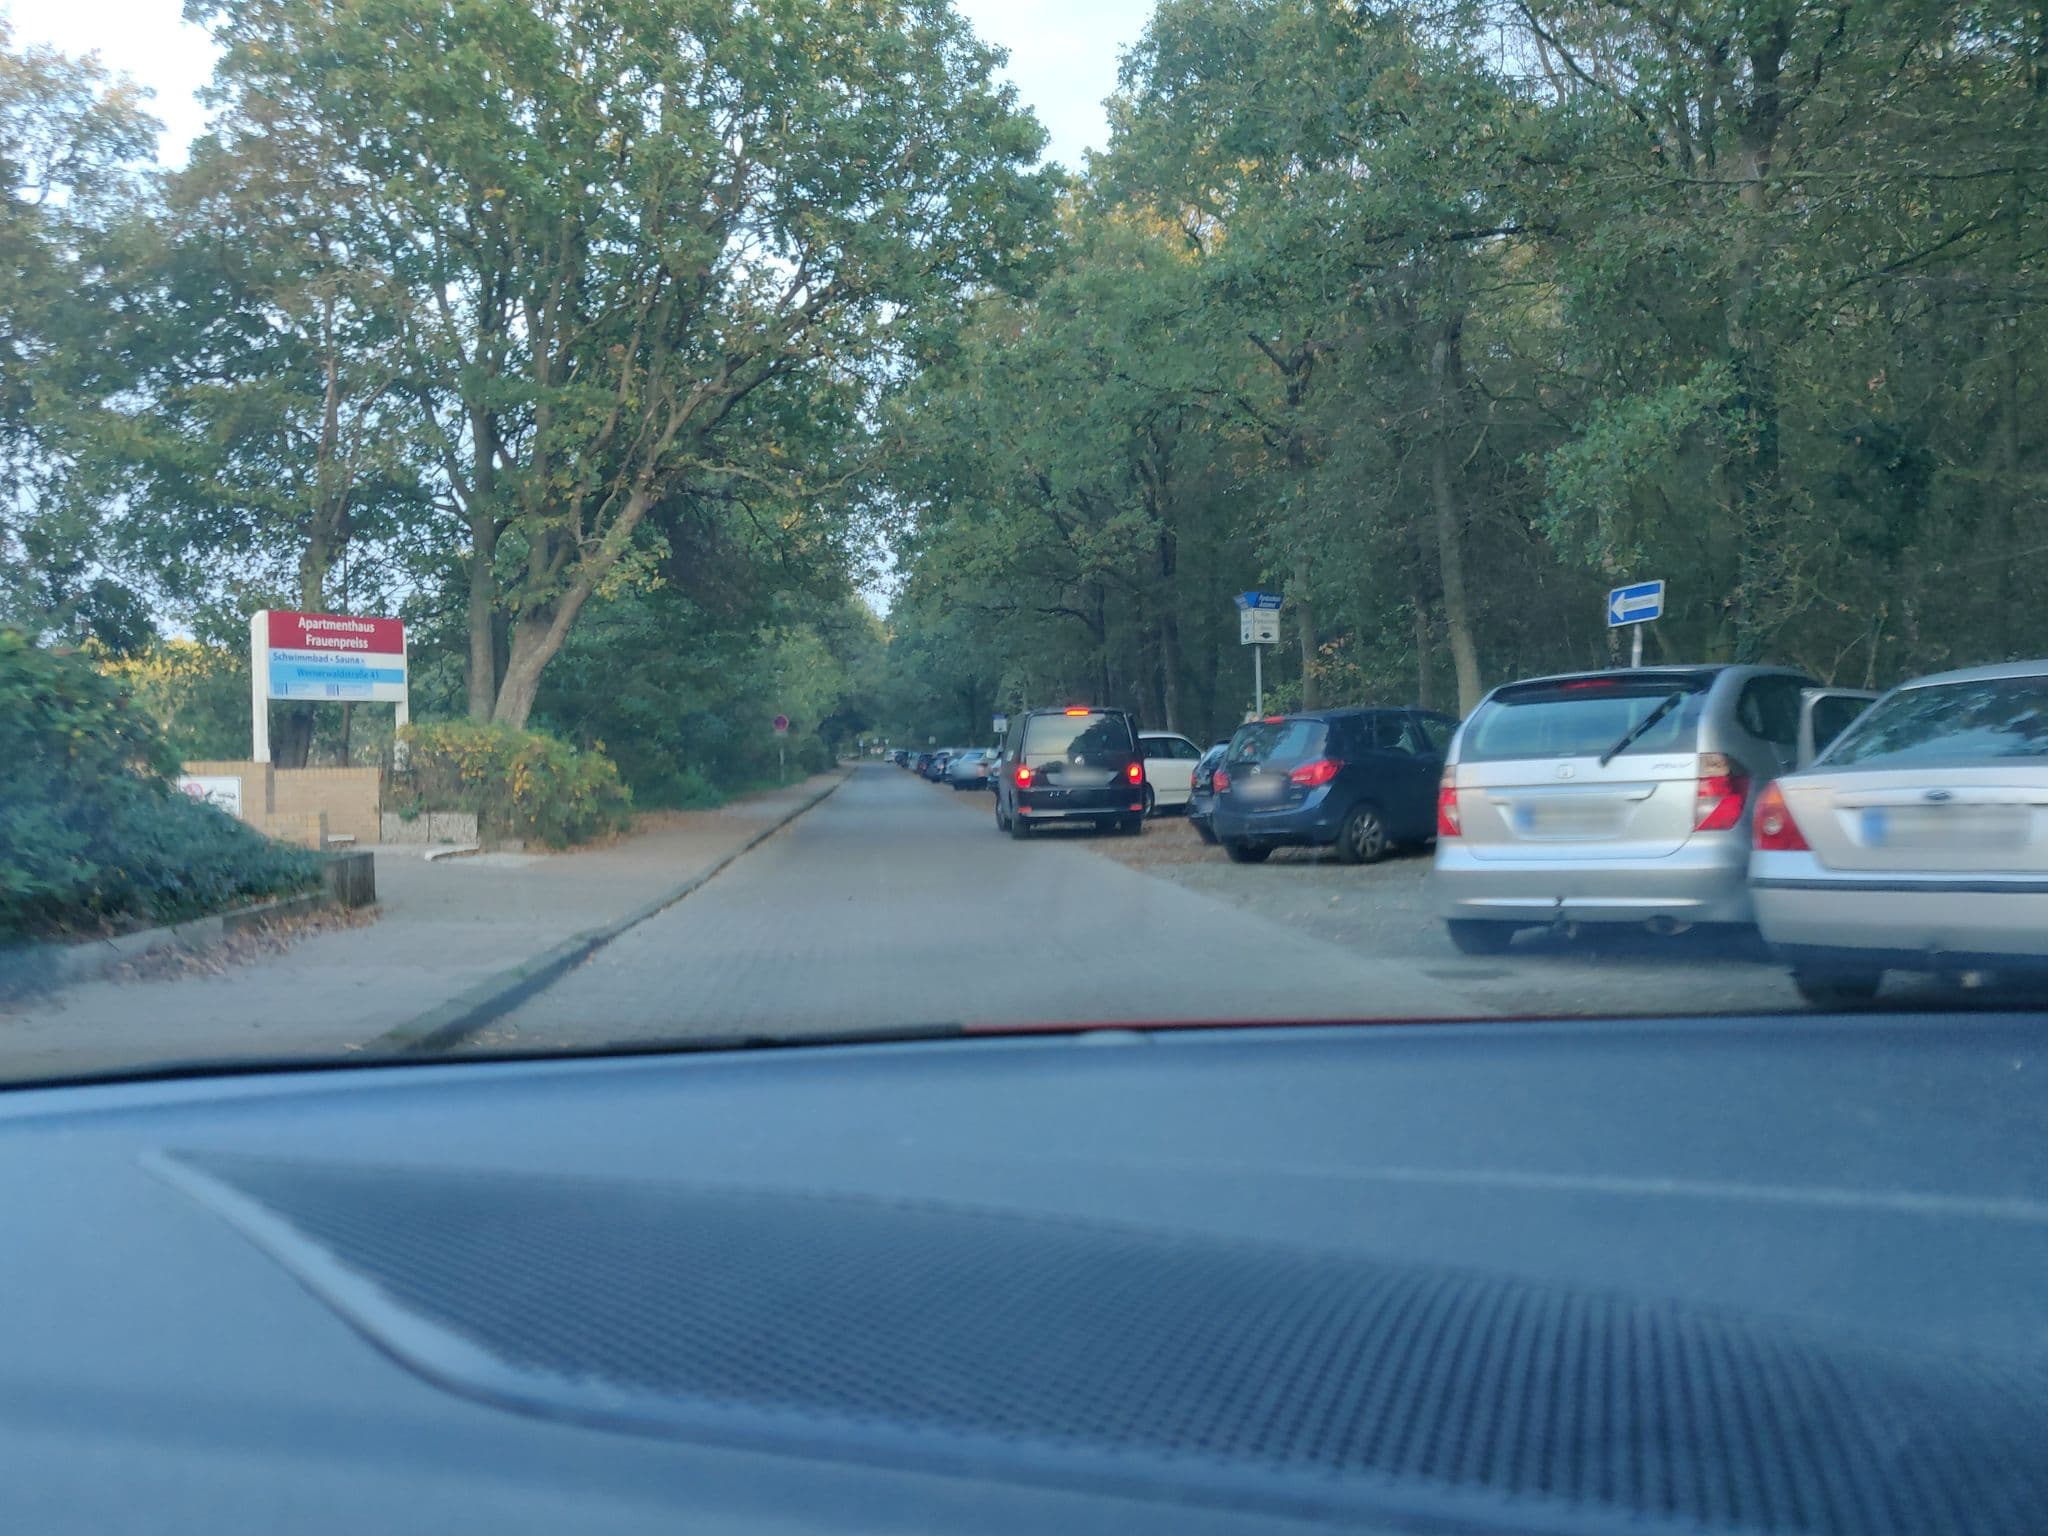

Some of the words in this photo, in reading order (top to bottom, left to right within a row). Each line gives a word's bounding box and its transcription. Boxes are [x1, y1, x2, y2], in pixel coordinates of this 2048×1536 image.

[298, 616, 375, 633] Apartmenthaus
[305, 634, 369, 650] Frauenpreiss
[273, 652, 329, 664] Schwimmbad
